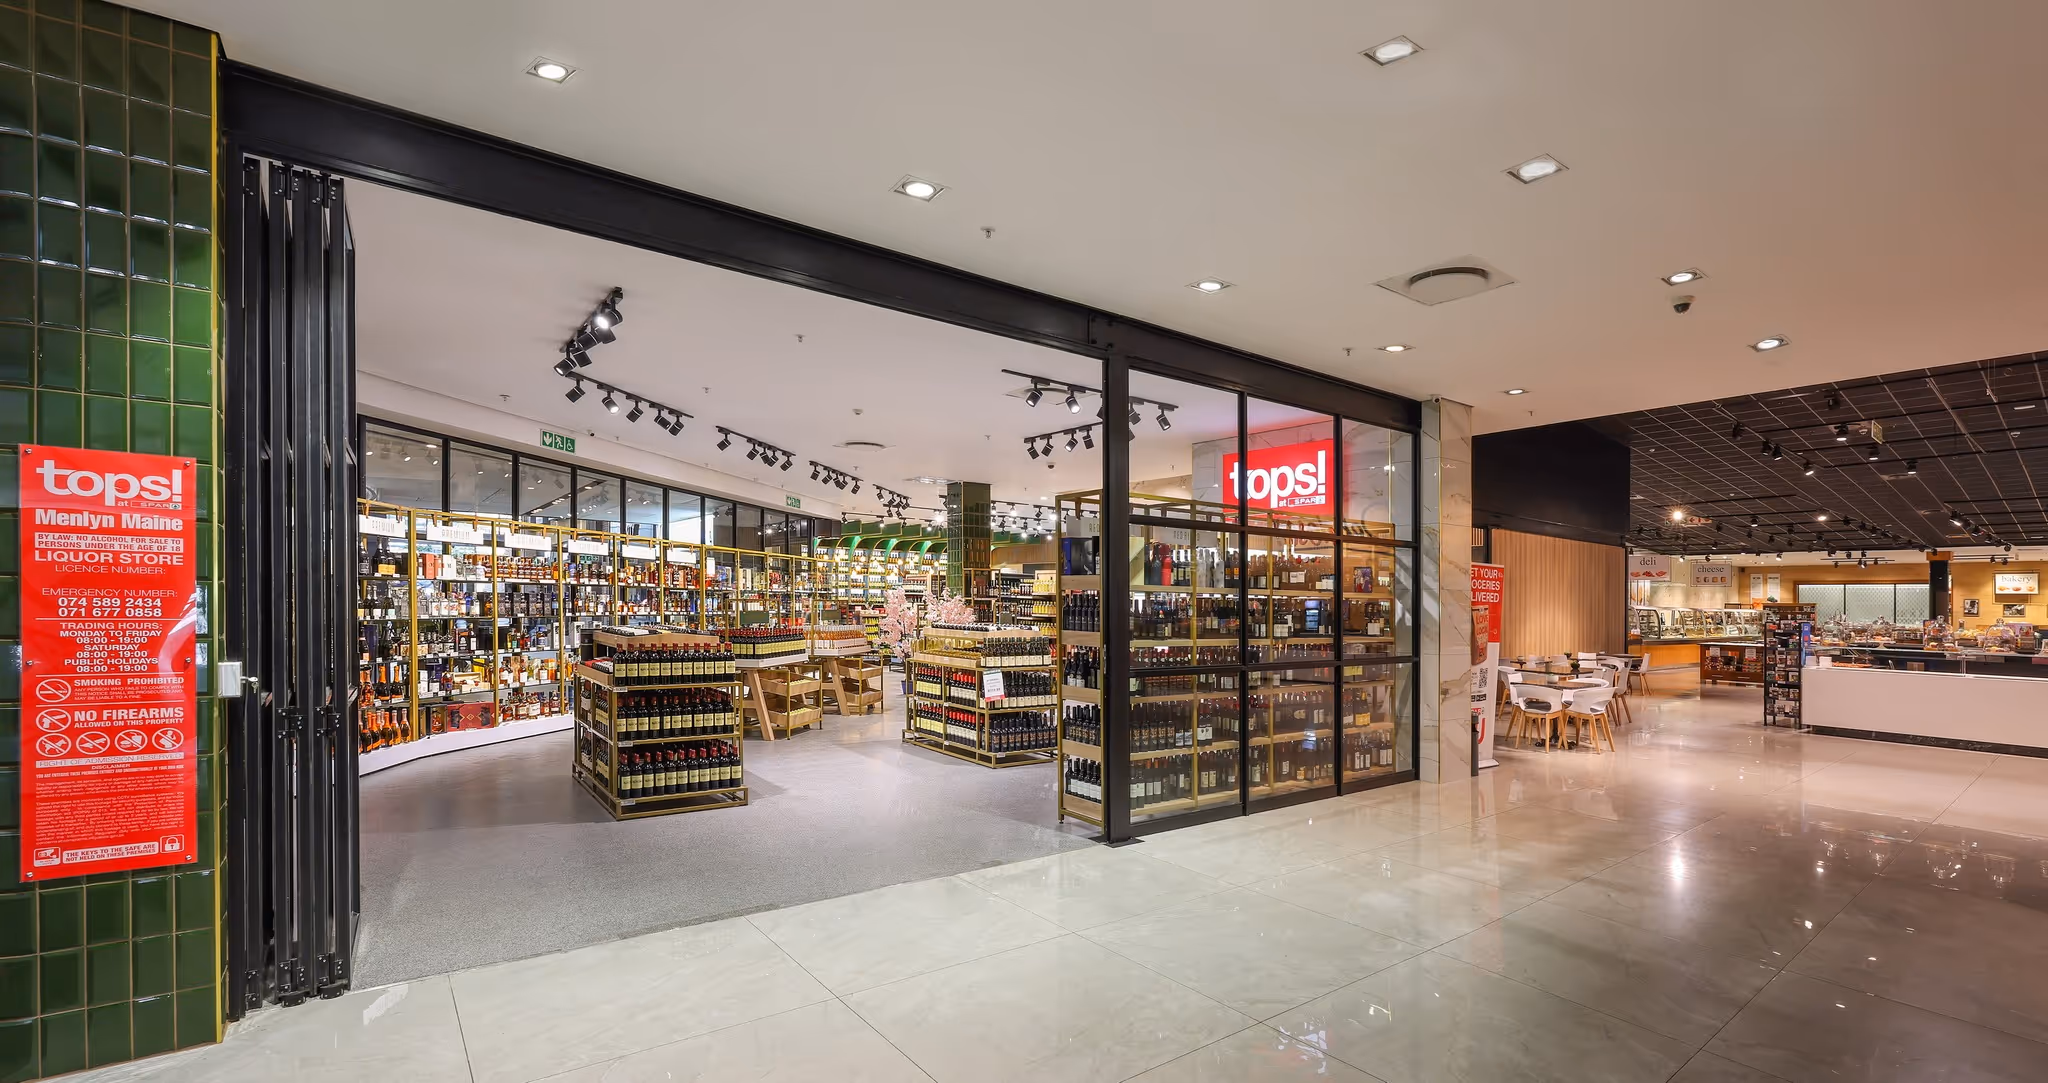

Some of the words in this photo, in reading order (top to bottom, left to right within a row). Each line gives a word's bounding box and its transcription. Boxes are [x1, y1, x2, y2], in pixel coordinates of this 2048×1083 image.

[36, 459, 182, 507] tops!
[1229, 450, 1326, 508] tops!
[1279, 499, 1287, 507] at
[35, 508, 115, 530] Menlyn
[121, 513, 184, 532] Maine
[34, 550, 114, 563] LIQUOR
[119, 552, 184, 566] STORE
[1640, 556, 1656, 566] deli
[56, 564, 109, 573] LICENCE
[111, 566, 166, 574] NUMBER:
[1471, 568, 1479, 578] ET
[1480, 568, 1498, 579] YOUR
[1697, 564, 1725, 572] cheese
[1471, 579, 1500, 590] OCERIES
[2001, 576, 2033, 584] bakery
[42, 588, 121, 596] EMERGENCY
[124, 589, 178, 598] NUMBER:
[1471, 591, 1500, 602] LIVERED
[58, 597, 88, 607] 074
[92, 598, 121, 607] 589
[125, 598, 162, 607] 2434
[58, 608, 86, 617] 071
[92, 608, 121, 617] 677
[125, 608, 162, 618] 0858
[74, 678, 122, 687] SMOKING
[127, 676, 184, 685] PROHIBITED
[74, 710, 98, 722] NO
[102, 706, 184, 720] FIREARMS
